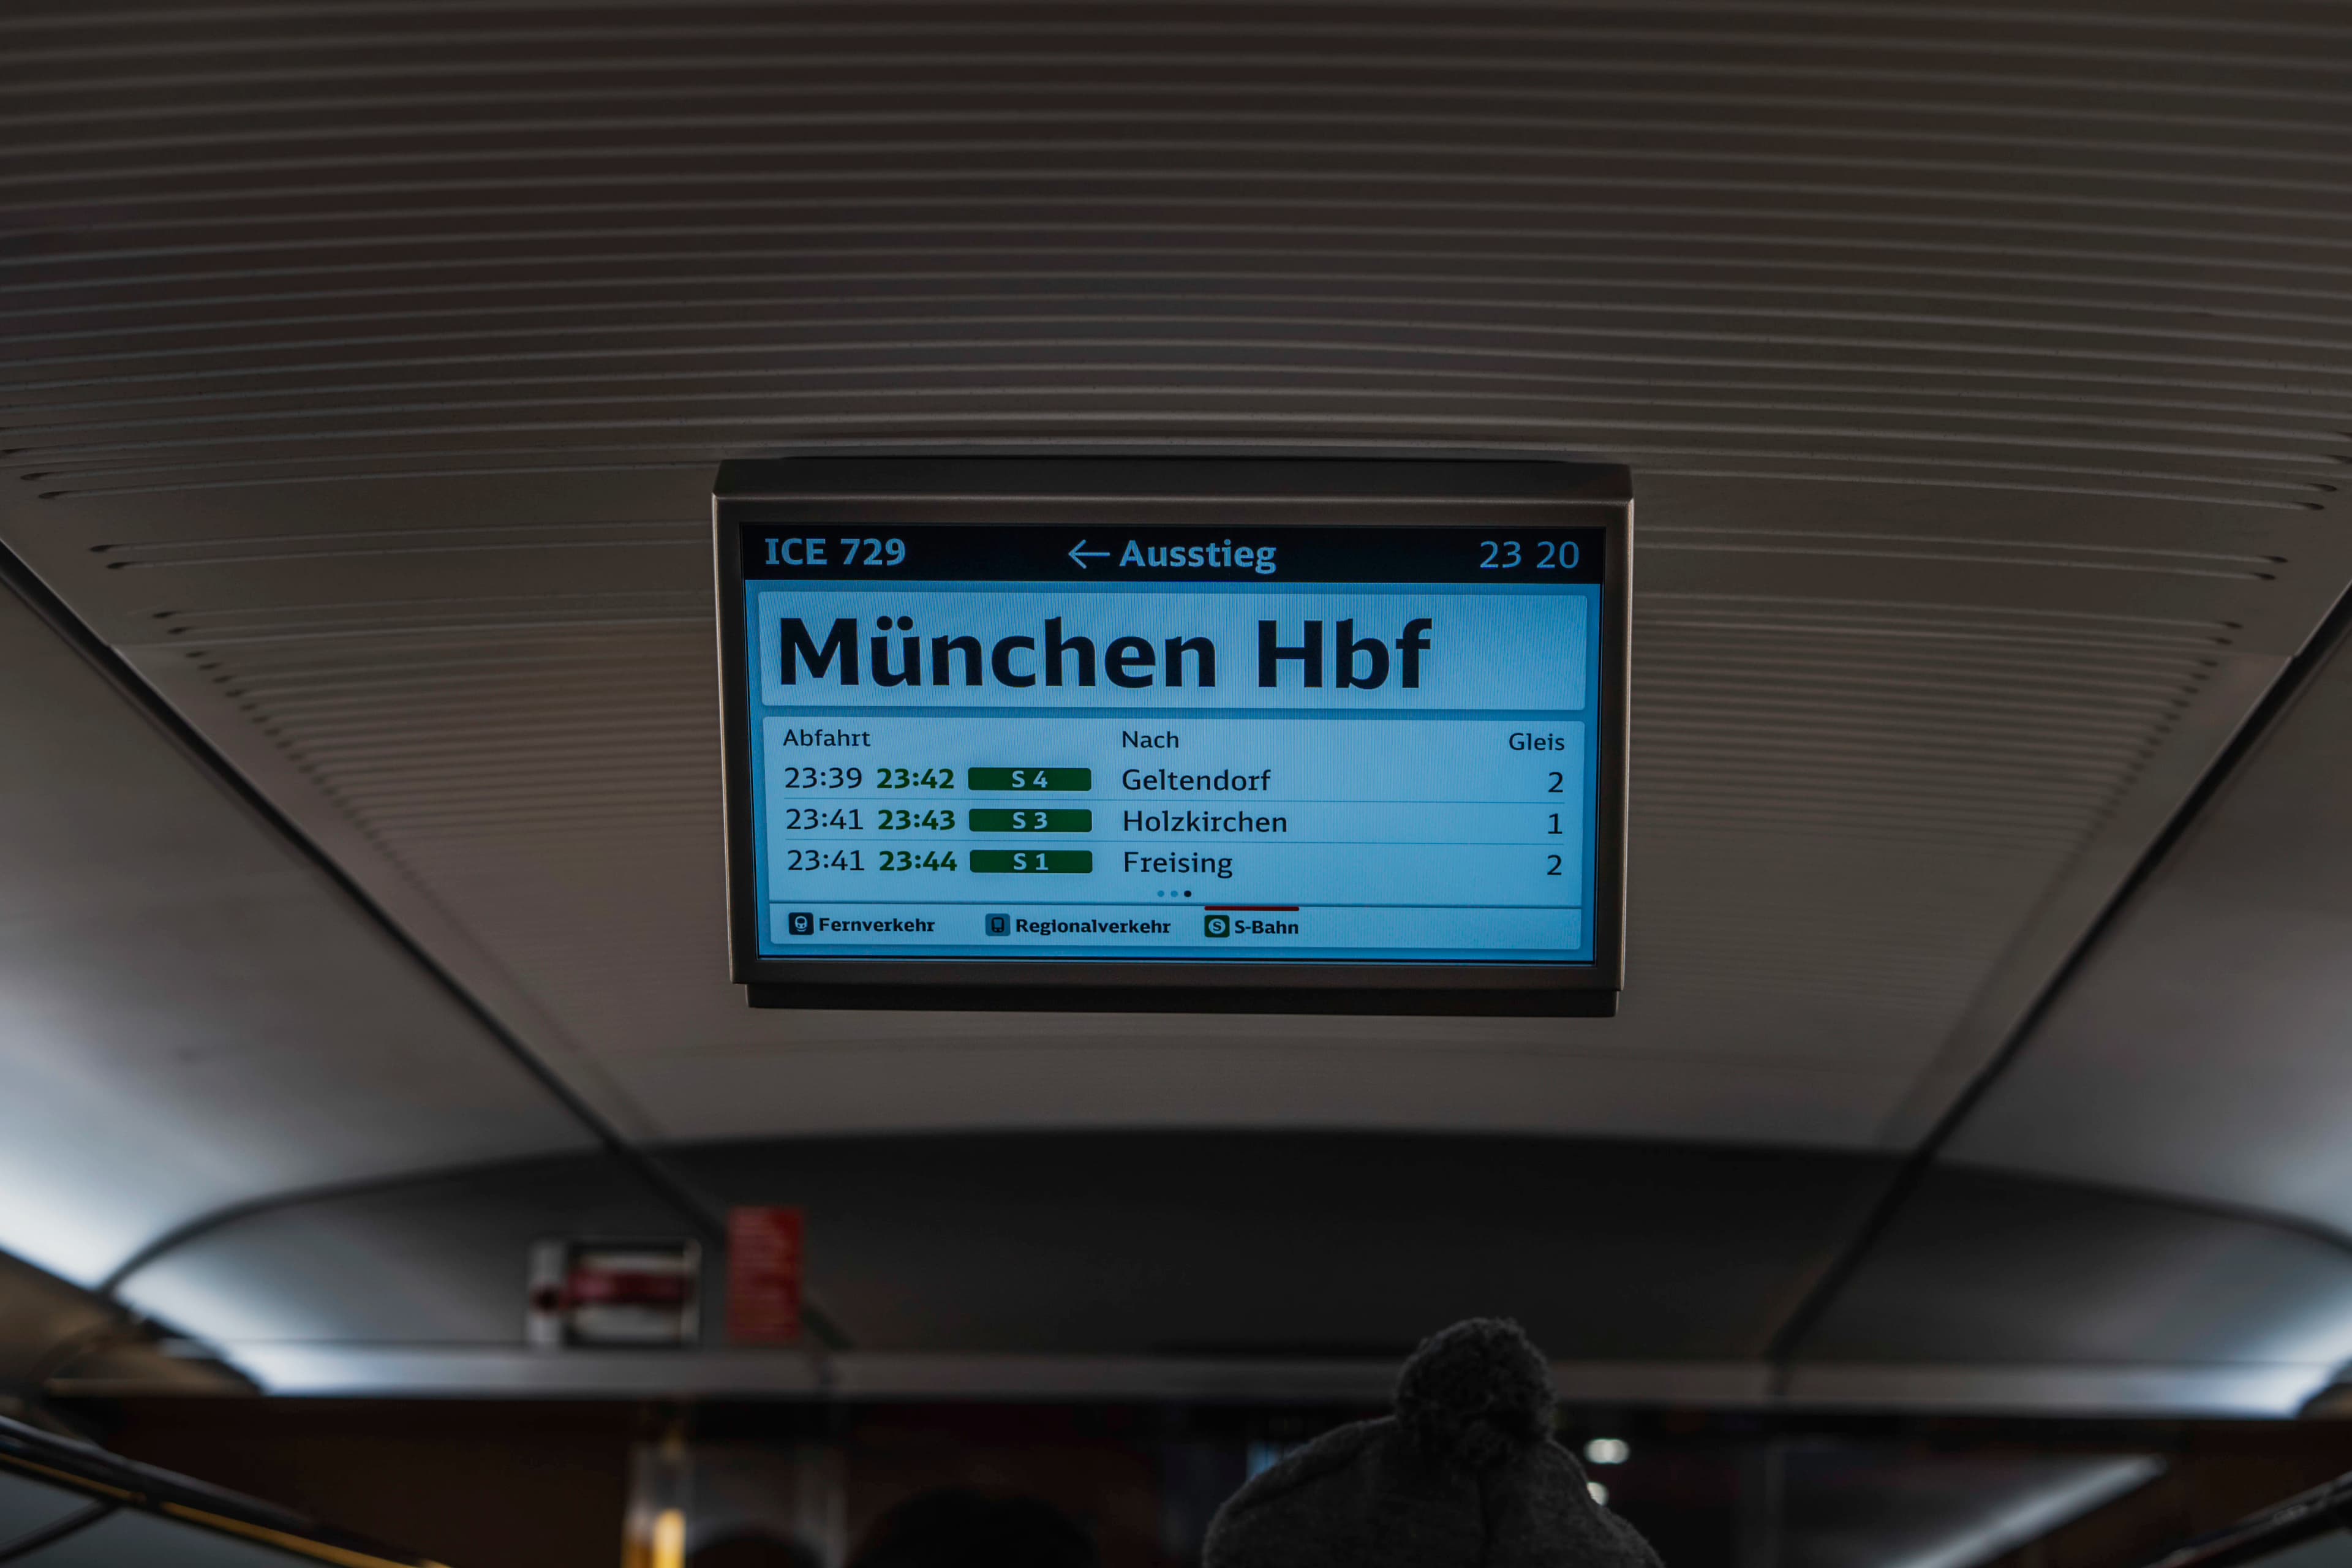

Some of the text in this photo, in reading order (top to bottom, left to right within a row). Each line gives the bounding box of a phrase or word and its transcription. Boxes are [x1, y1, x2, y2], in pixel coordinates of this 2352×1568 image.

[764, 538, 907, 567] ICE 729
[1119, 539, 1277, 575] Ausstieg
[1479, 540, 1580, 569] 23 20
[780, 615, 1433, 690] München Hbf
[782, 728, 871, 748] Abfahrt
[1121, 730, 1180, 750] Nach
[1508, 732, 1566, 753] Gleis
[784, 767, 1564, 793] 23:39 23:42 S 4 Geltendorf 2
[785, 809, 1563, 835] 23:41 23:43 S 3 Holzkirchen 1
[786, 850, 1563, 878] 23:41 23:44 S 1 Freising 2
[819, 917, 935, 933] Fernverkehr
[1015, 918, 1171, 937] Regionalverkehr
[1234, 919, 1300, 935] S-Bahn
